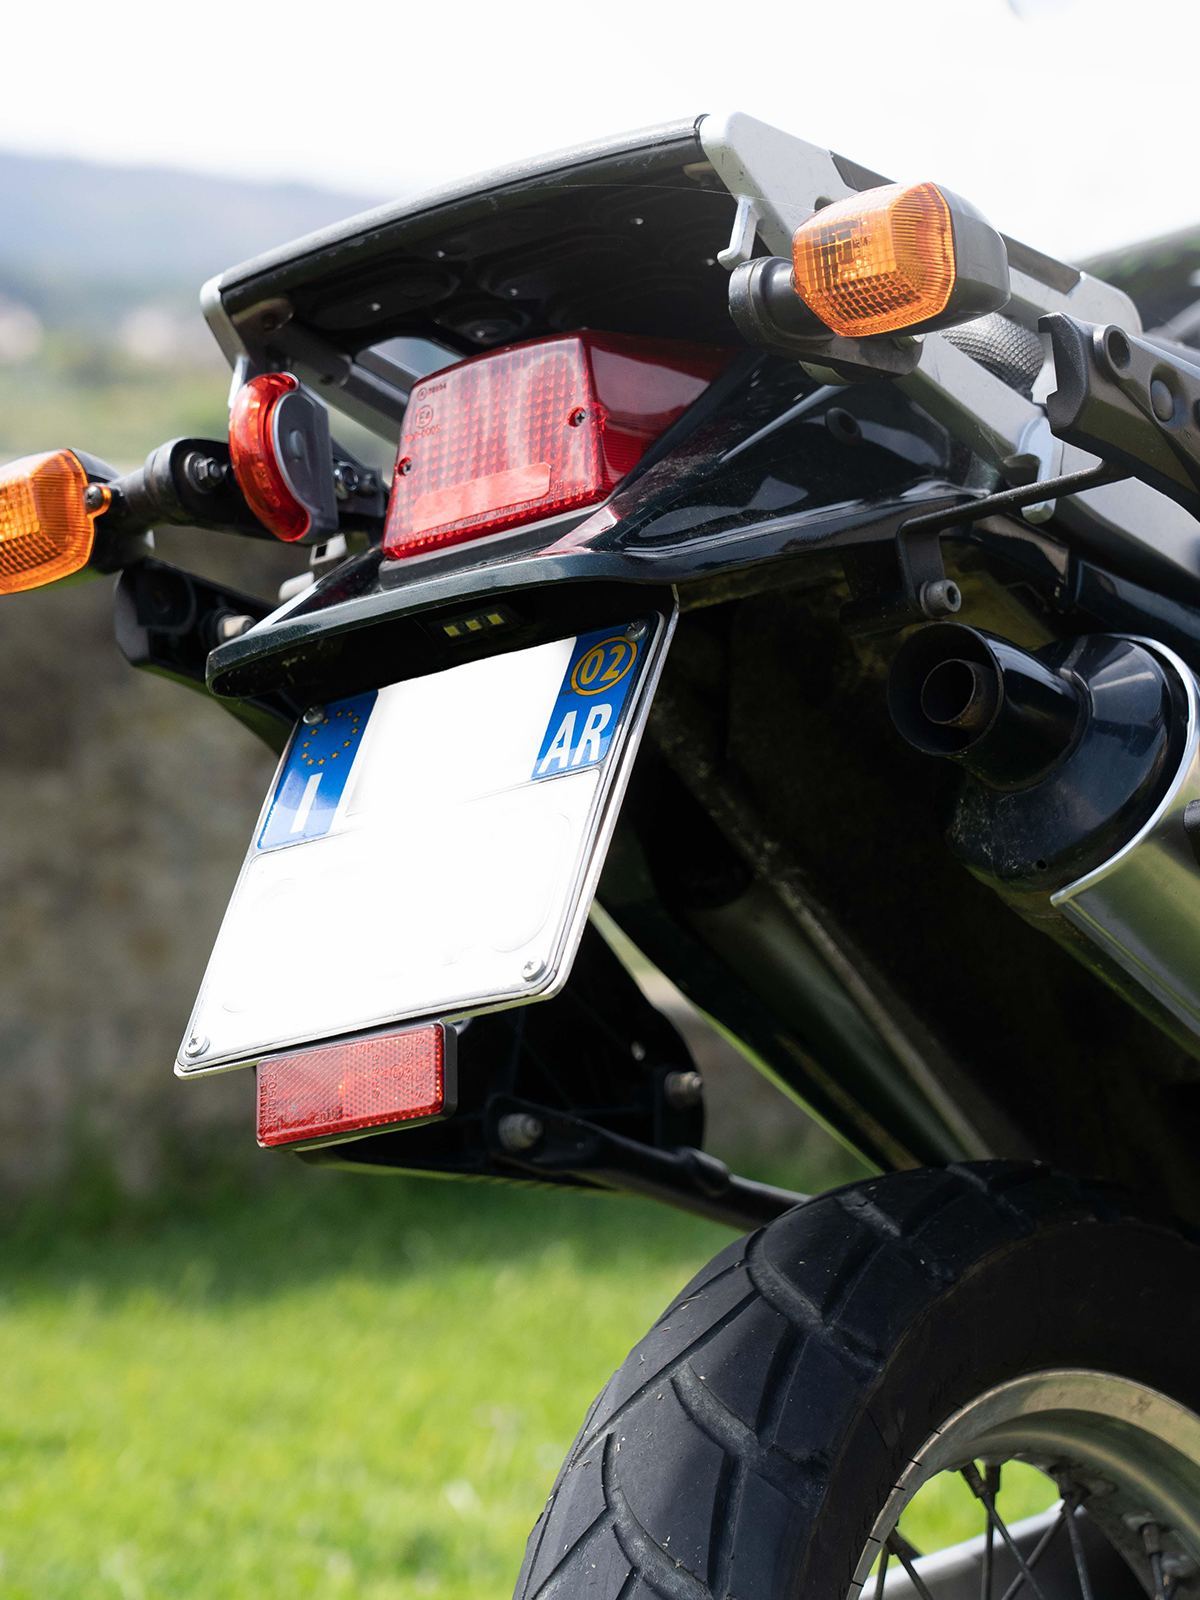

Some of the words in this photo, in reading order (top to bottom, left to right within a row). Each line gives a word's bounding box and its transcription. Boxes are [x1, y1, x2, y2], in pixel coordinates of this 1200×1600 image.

[580, 644, 626, 685] 02
[536, 703, 612, 774] AR
[289, 772, 323, 834] I
[354, 1043, 374, 1055] TOP
[415, 1076, 425, 1099] SAE
